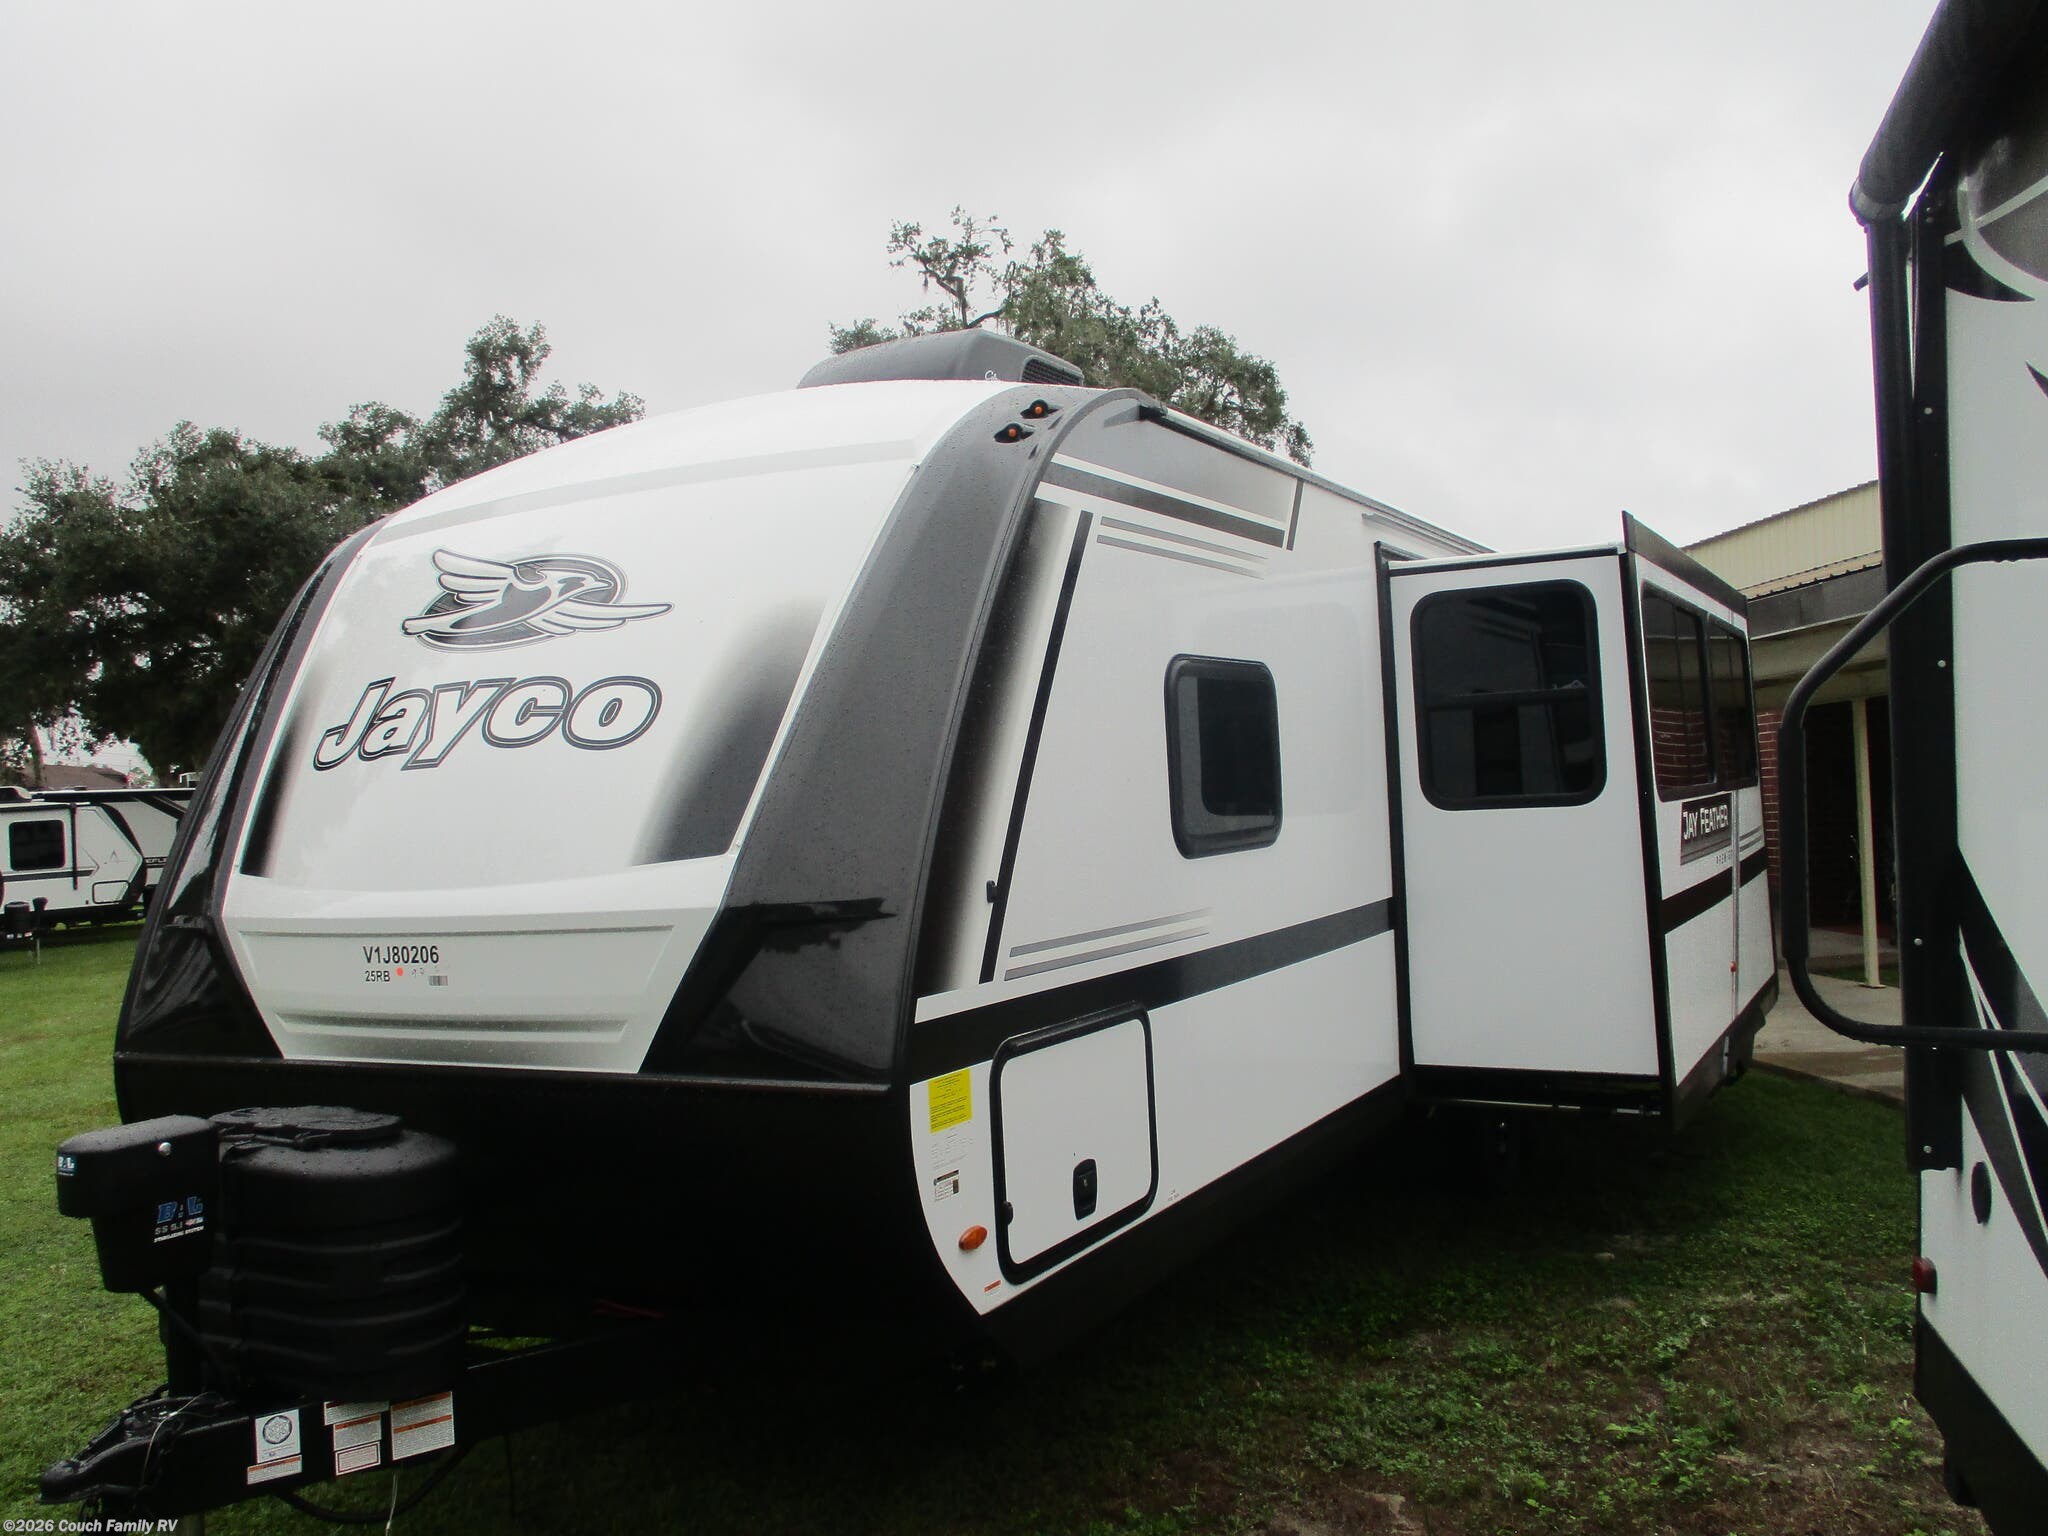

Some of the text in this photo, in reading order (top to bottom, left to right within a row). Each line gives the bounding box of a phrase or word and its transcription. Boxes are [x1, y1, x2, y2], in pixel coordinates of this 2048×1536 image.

[313, 676, 663, 772] Jayco
[1682, 804, 1729, 840] JAY FEATHER
[363, 945, 440, 964] V1J80206
[364, 970, 391, 982] 25RB
